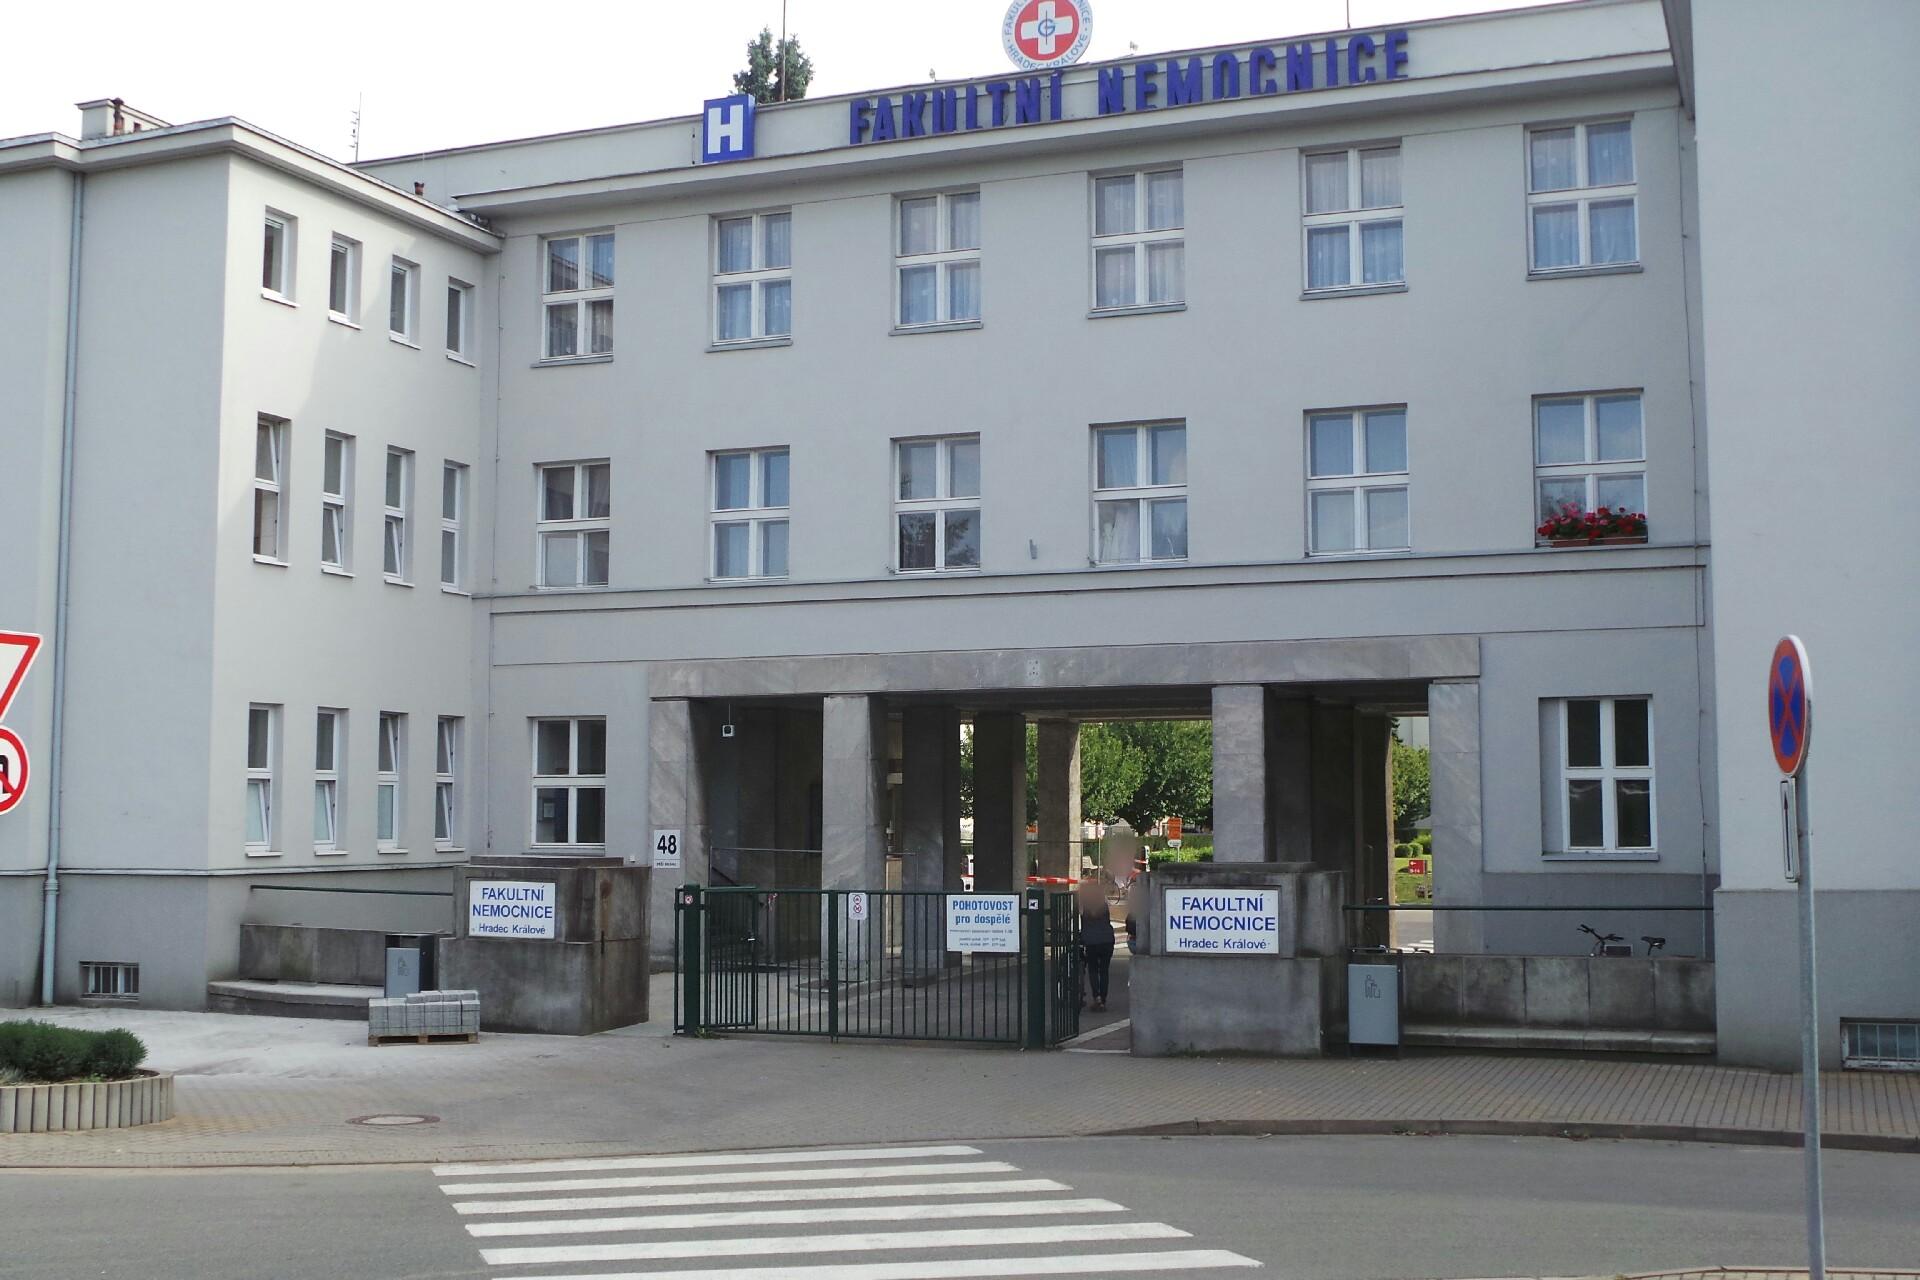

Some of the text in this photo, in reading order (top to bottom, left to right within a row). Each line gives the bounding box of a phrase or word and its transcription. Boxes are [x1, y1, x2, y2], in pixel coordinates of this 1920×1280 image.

[849, 29, 1409, 146] FAKULTNÍ NEMOCNICE
[707, 103, 744, 154] H
[656, 834, 677, 855] 48
[482, 885, 545, 902] FAKULTNÍ
[952, 900, 1014, 911] POHOTOVOST
[1181, 893, 1264, 912] FAKULTNÍ
[472, 904, 553, 919] NEMOCNICE
[955, 913, 1011, 926] pro dospělé
[479, 923, 546, 935] Hradec Králové
[1169, 915, 1276, 931] NEMOCNICE
[1179, 937, 1267, 949] Hradec Králové
